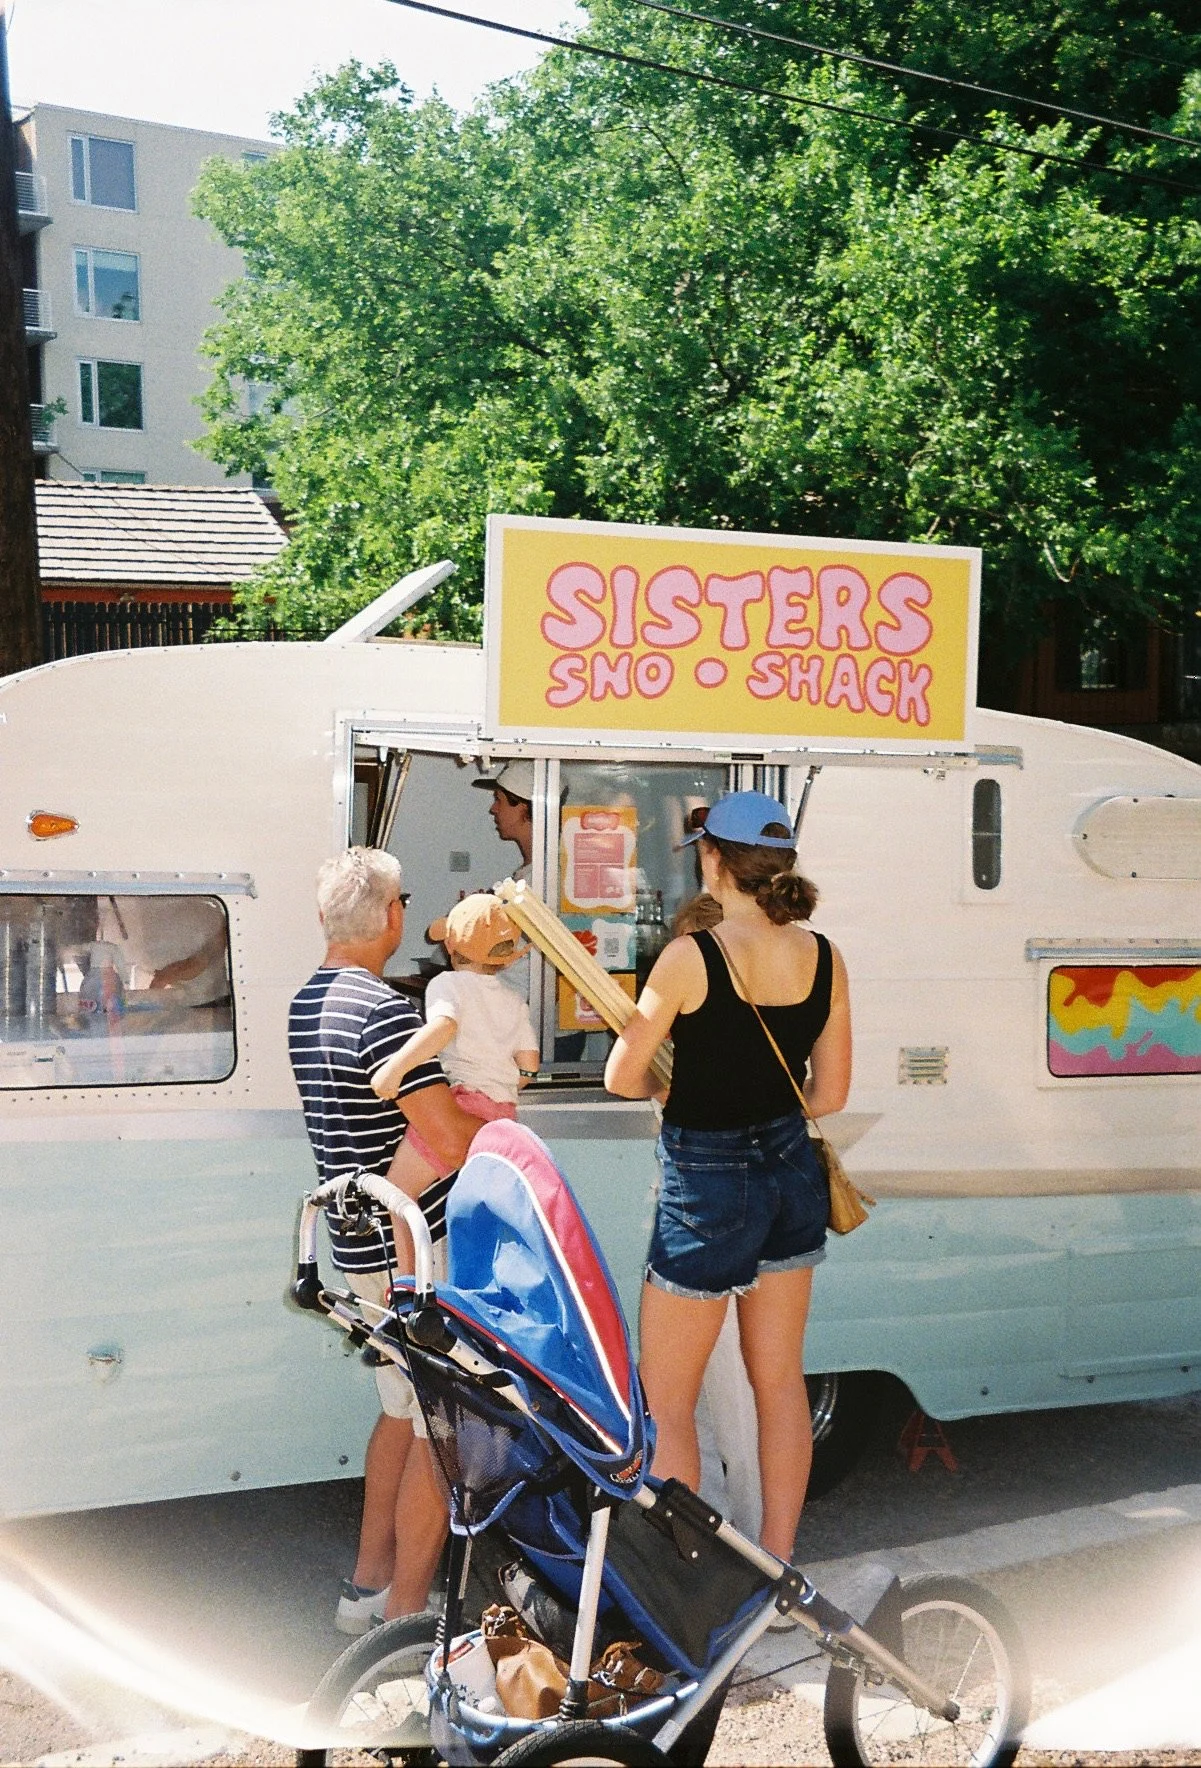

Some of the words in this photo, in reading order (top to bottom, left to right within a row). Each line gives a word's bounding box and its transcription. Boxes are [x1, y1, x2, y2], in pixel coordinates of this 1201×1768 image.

[541, 562, 934, 655] SISTERS
[546, 653, 674, 707] SNO
[747, 651, 932, 726] SHACK
